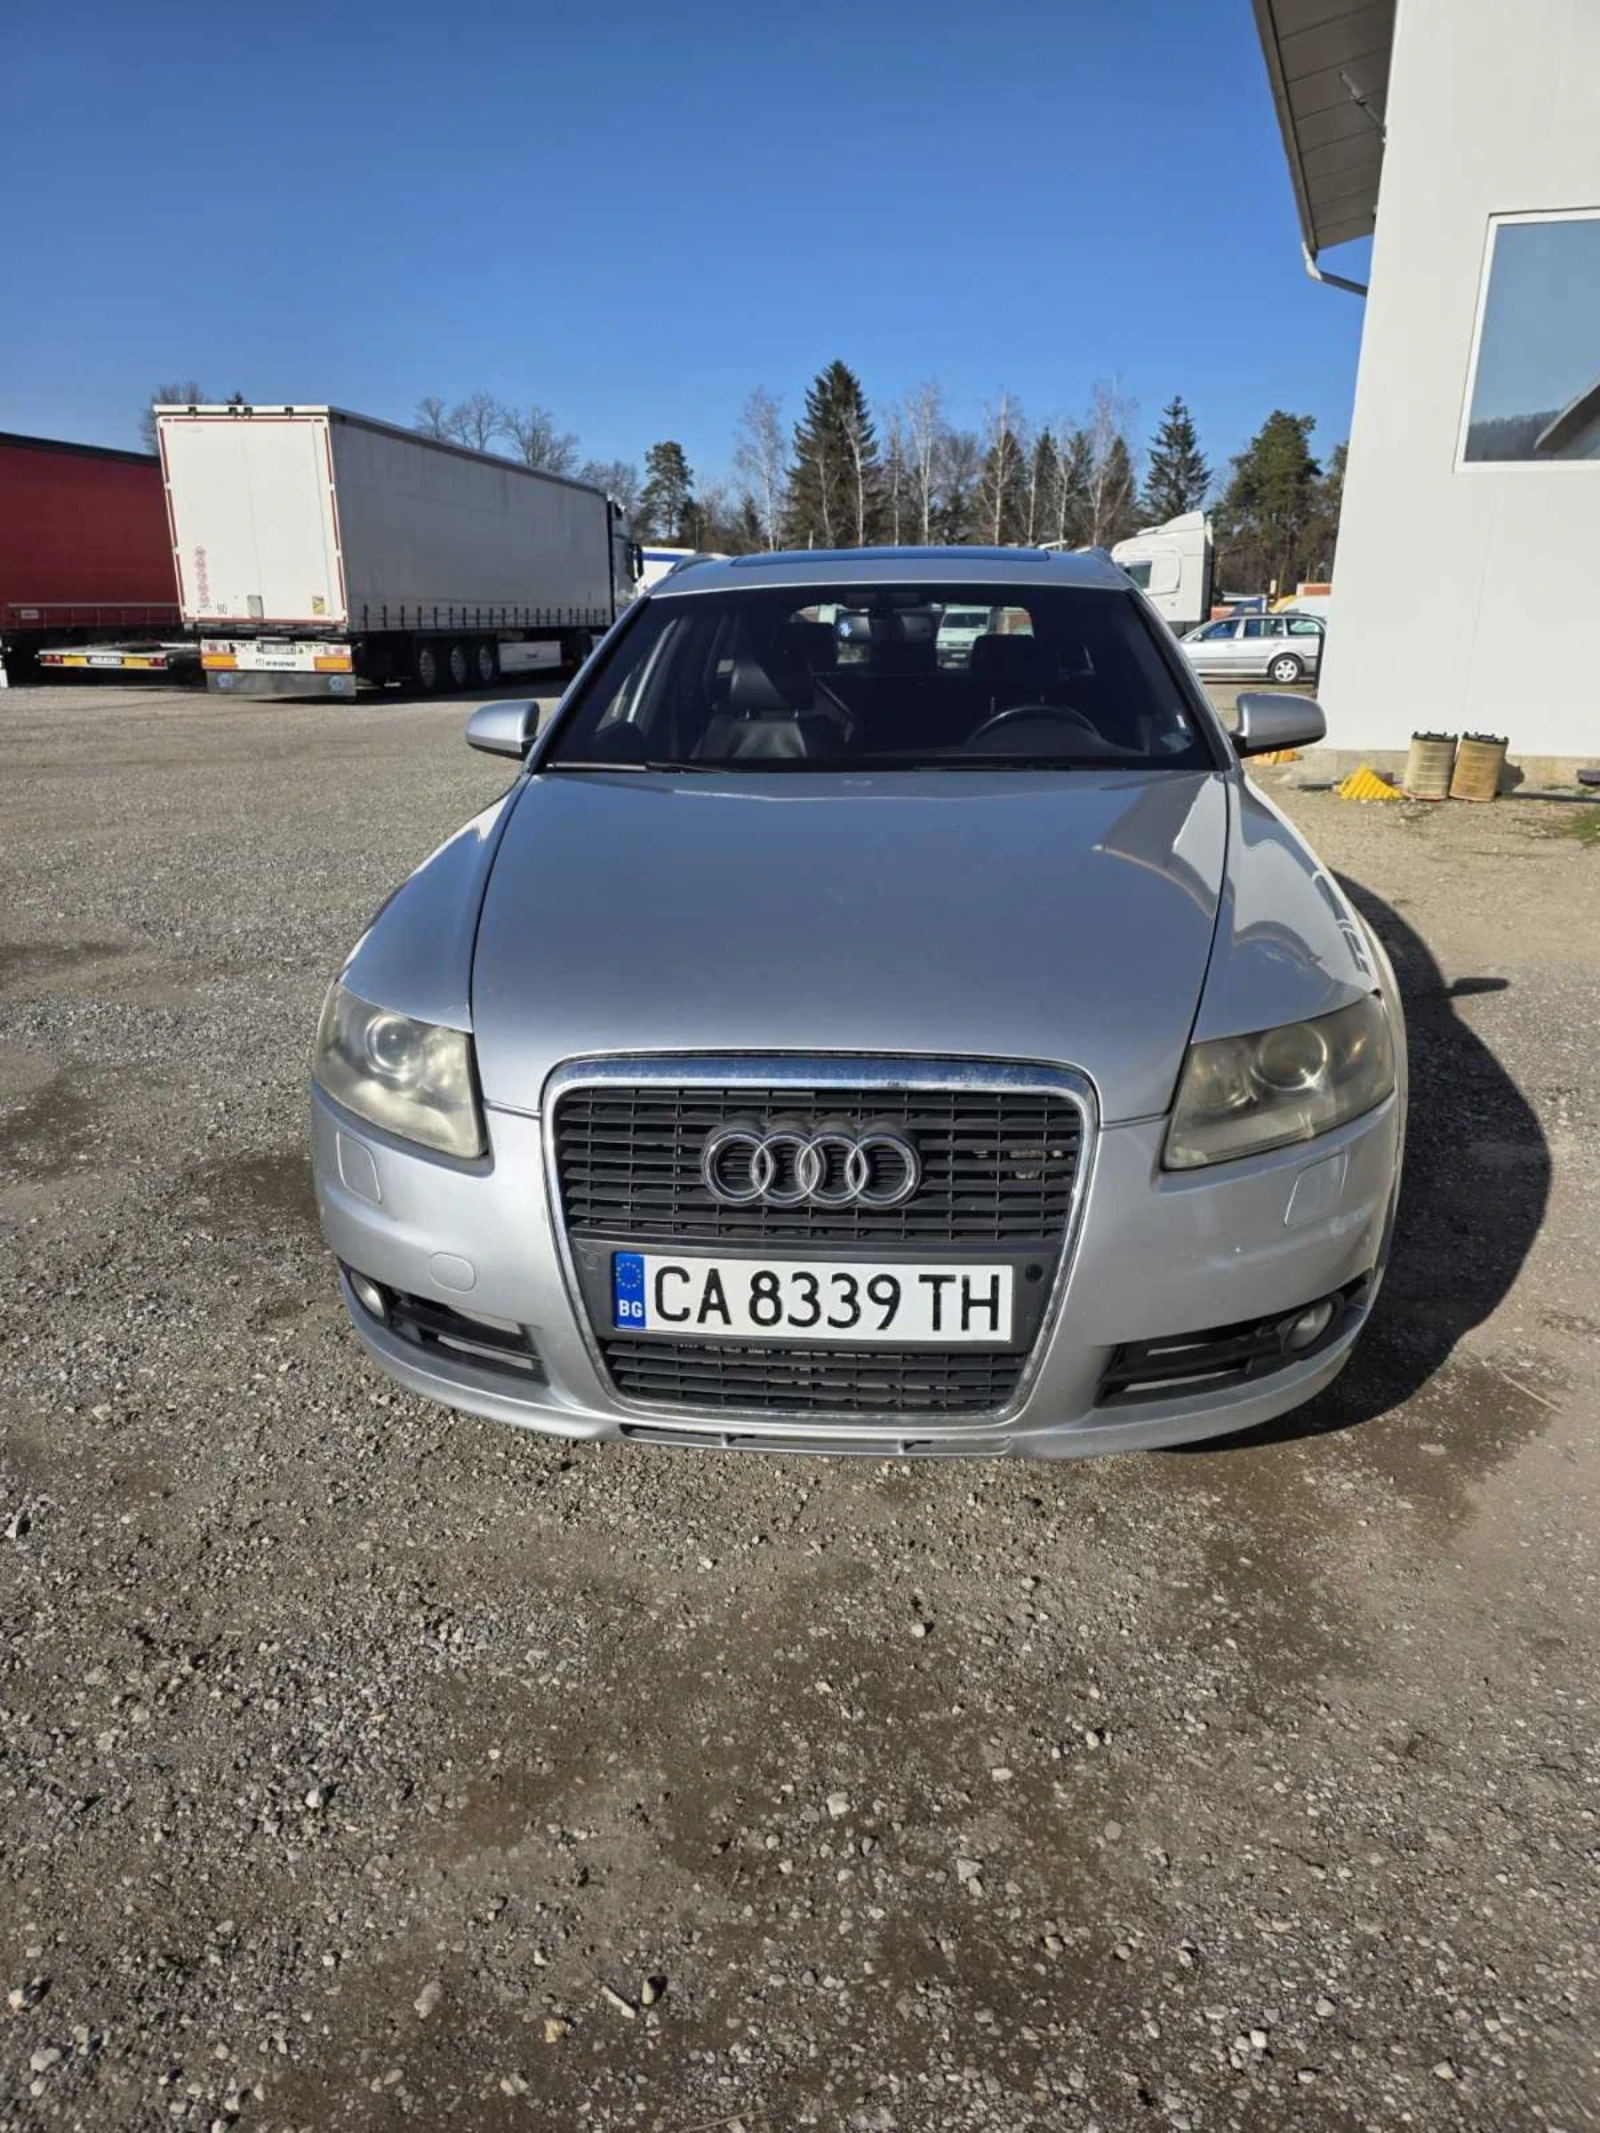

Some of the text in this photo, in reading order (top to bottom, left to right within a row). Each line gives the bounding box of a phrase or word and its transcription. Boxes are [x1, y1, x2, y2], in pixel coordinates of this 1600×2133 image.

[618, 1299, 644, 1319] BG
[654, 1265, 1001, 1332] CA 8339 TH
